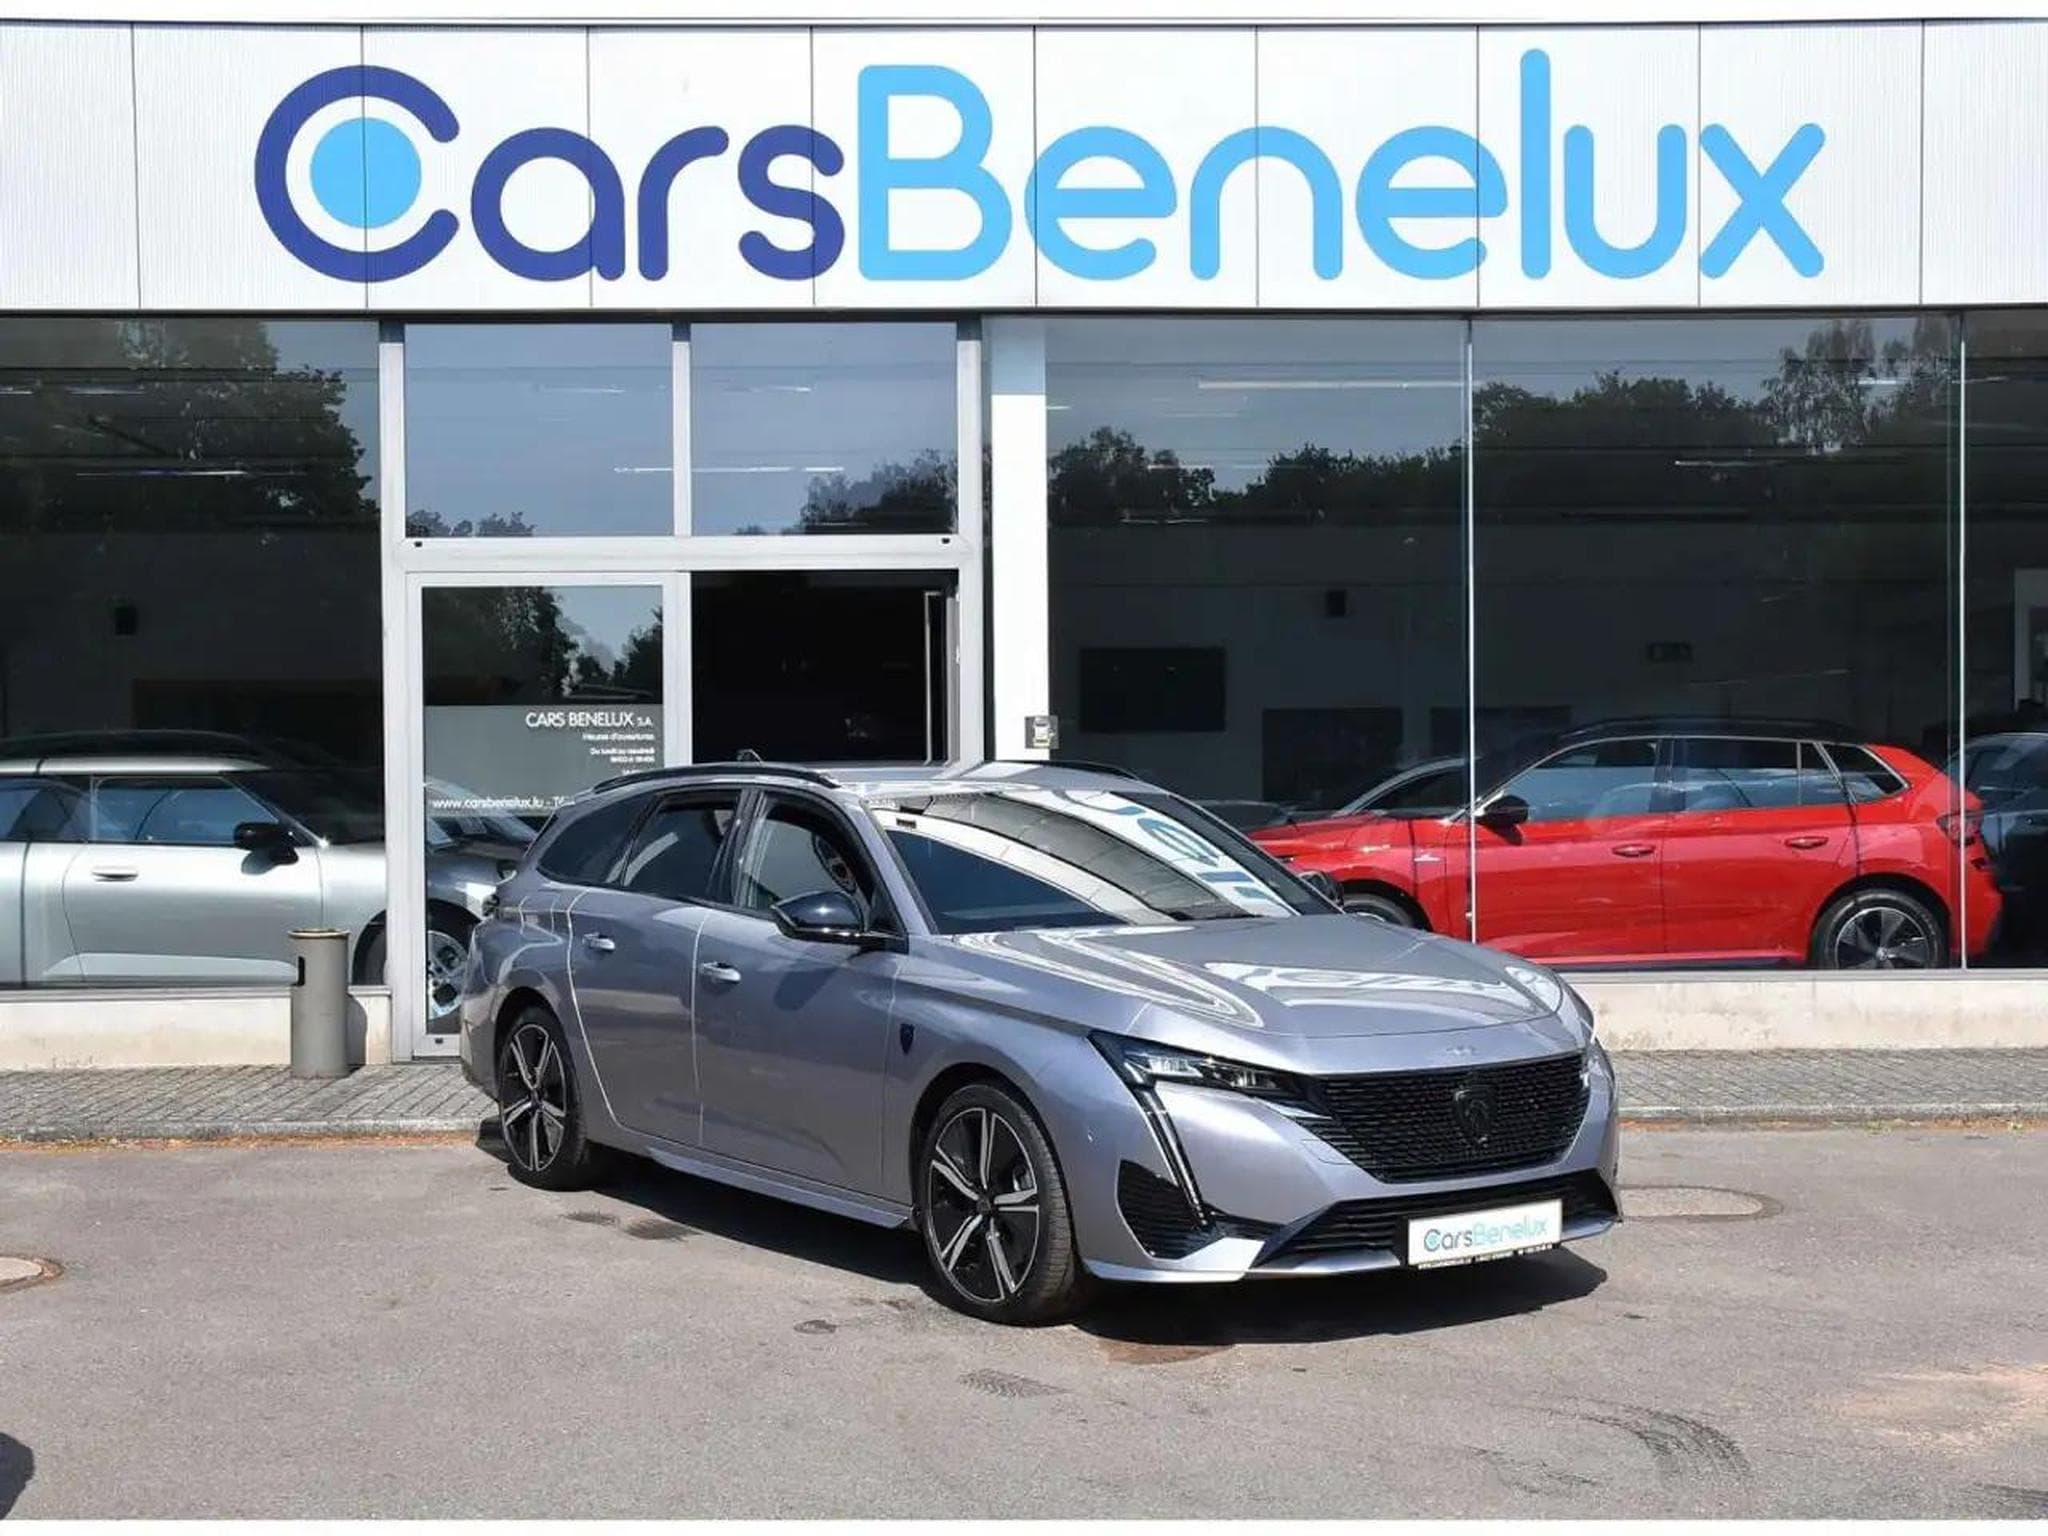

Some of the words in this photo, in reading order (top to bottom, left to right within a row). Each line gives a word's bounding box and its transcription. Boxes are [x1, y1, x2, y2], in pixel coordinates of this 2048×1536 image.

[254, 48, 1826, 284] CarsBenelux
[525, 711, 566, 728] CARS
[568, 711, 635, 728] BENELUX
[432, 796, 544, 809] www.carsbenelux.lu
[1423, 1215, 1549, 1252] CarsBenelux
